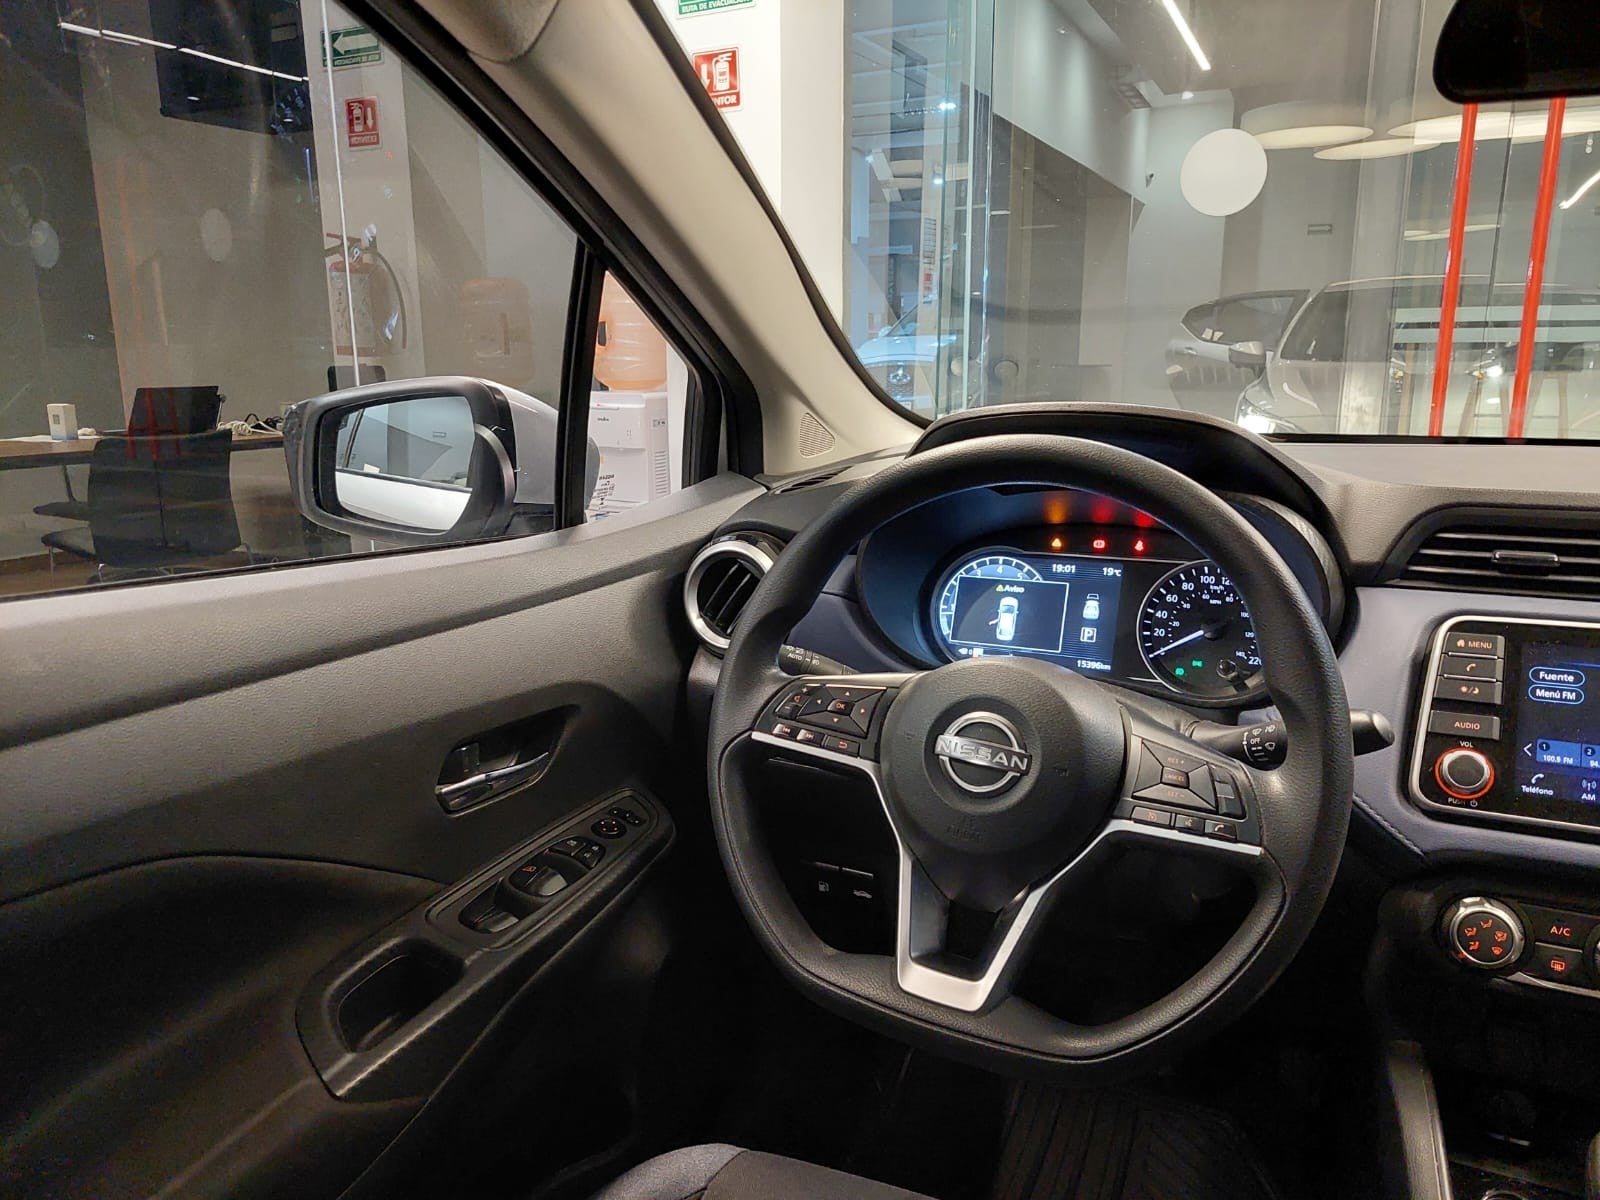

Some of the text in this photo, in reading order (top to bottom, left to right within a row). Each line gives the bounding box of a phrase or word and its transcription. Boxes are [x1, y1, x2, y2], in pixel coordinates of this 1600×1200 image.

[1052, 563, 1076, 573] 19:01
[1200, 575, 1215, 584] 100
[1221, 577, 1233, 585] 12
[1005, 584, 1025, 593] Aviso
[1181, 582, 1194, 591] 80
[1166, 594, 1178, 603] 60
[1155, 610, 1168, 619] 40
[1153, 628, 1165, 637] 20
[1468, 640, 1492, 649] MENU
[787, 653, 803, 661] AUTO
[1248, 657, 1262, 665] 22
[1539, 671, 1575, 682] Fuente
[1536, 687, 1576, 700] Menú FM
[1454, 721, 1480, 730] AUDIO
[936, 736, 1028, 770] NISSAN
[1563, 757, 1573, 765] FM
[1521, 785, 1554, 796] Teléfono
[1550, 926, 1571, 936] A/C
